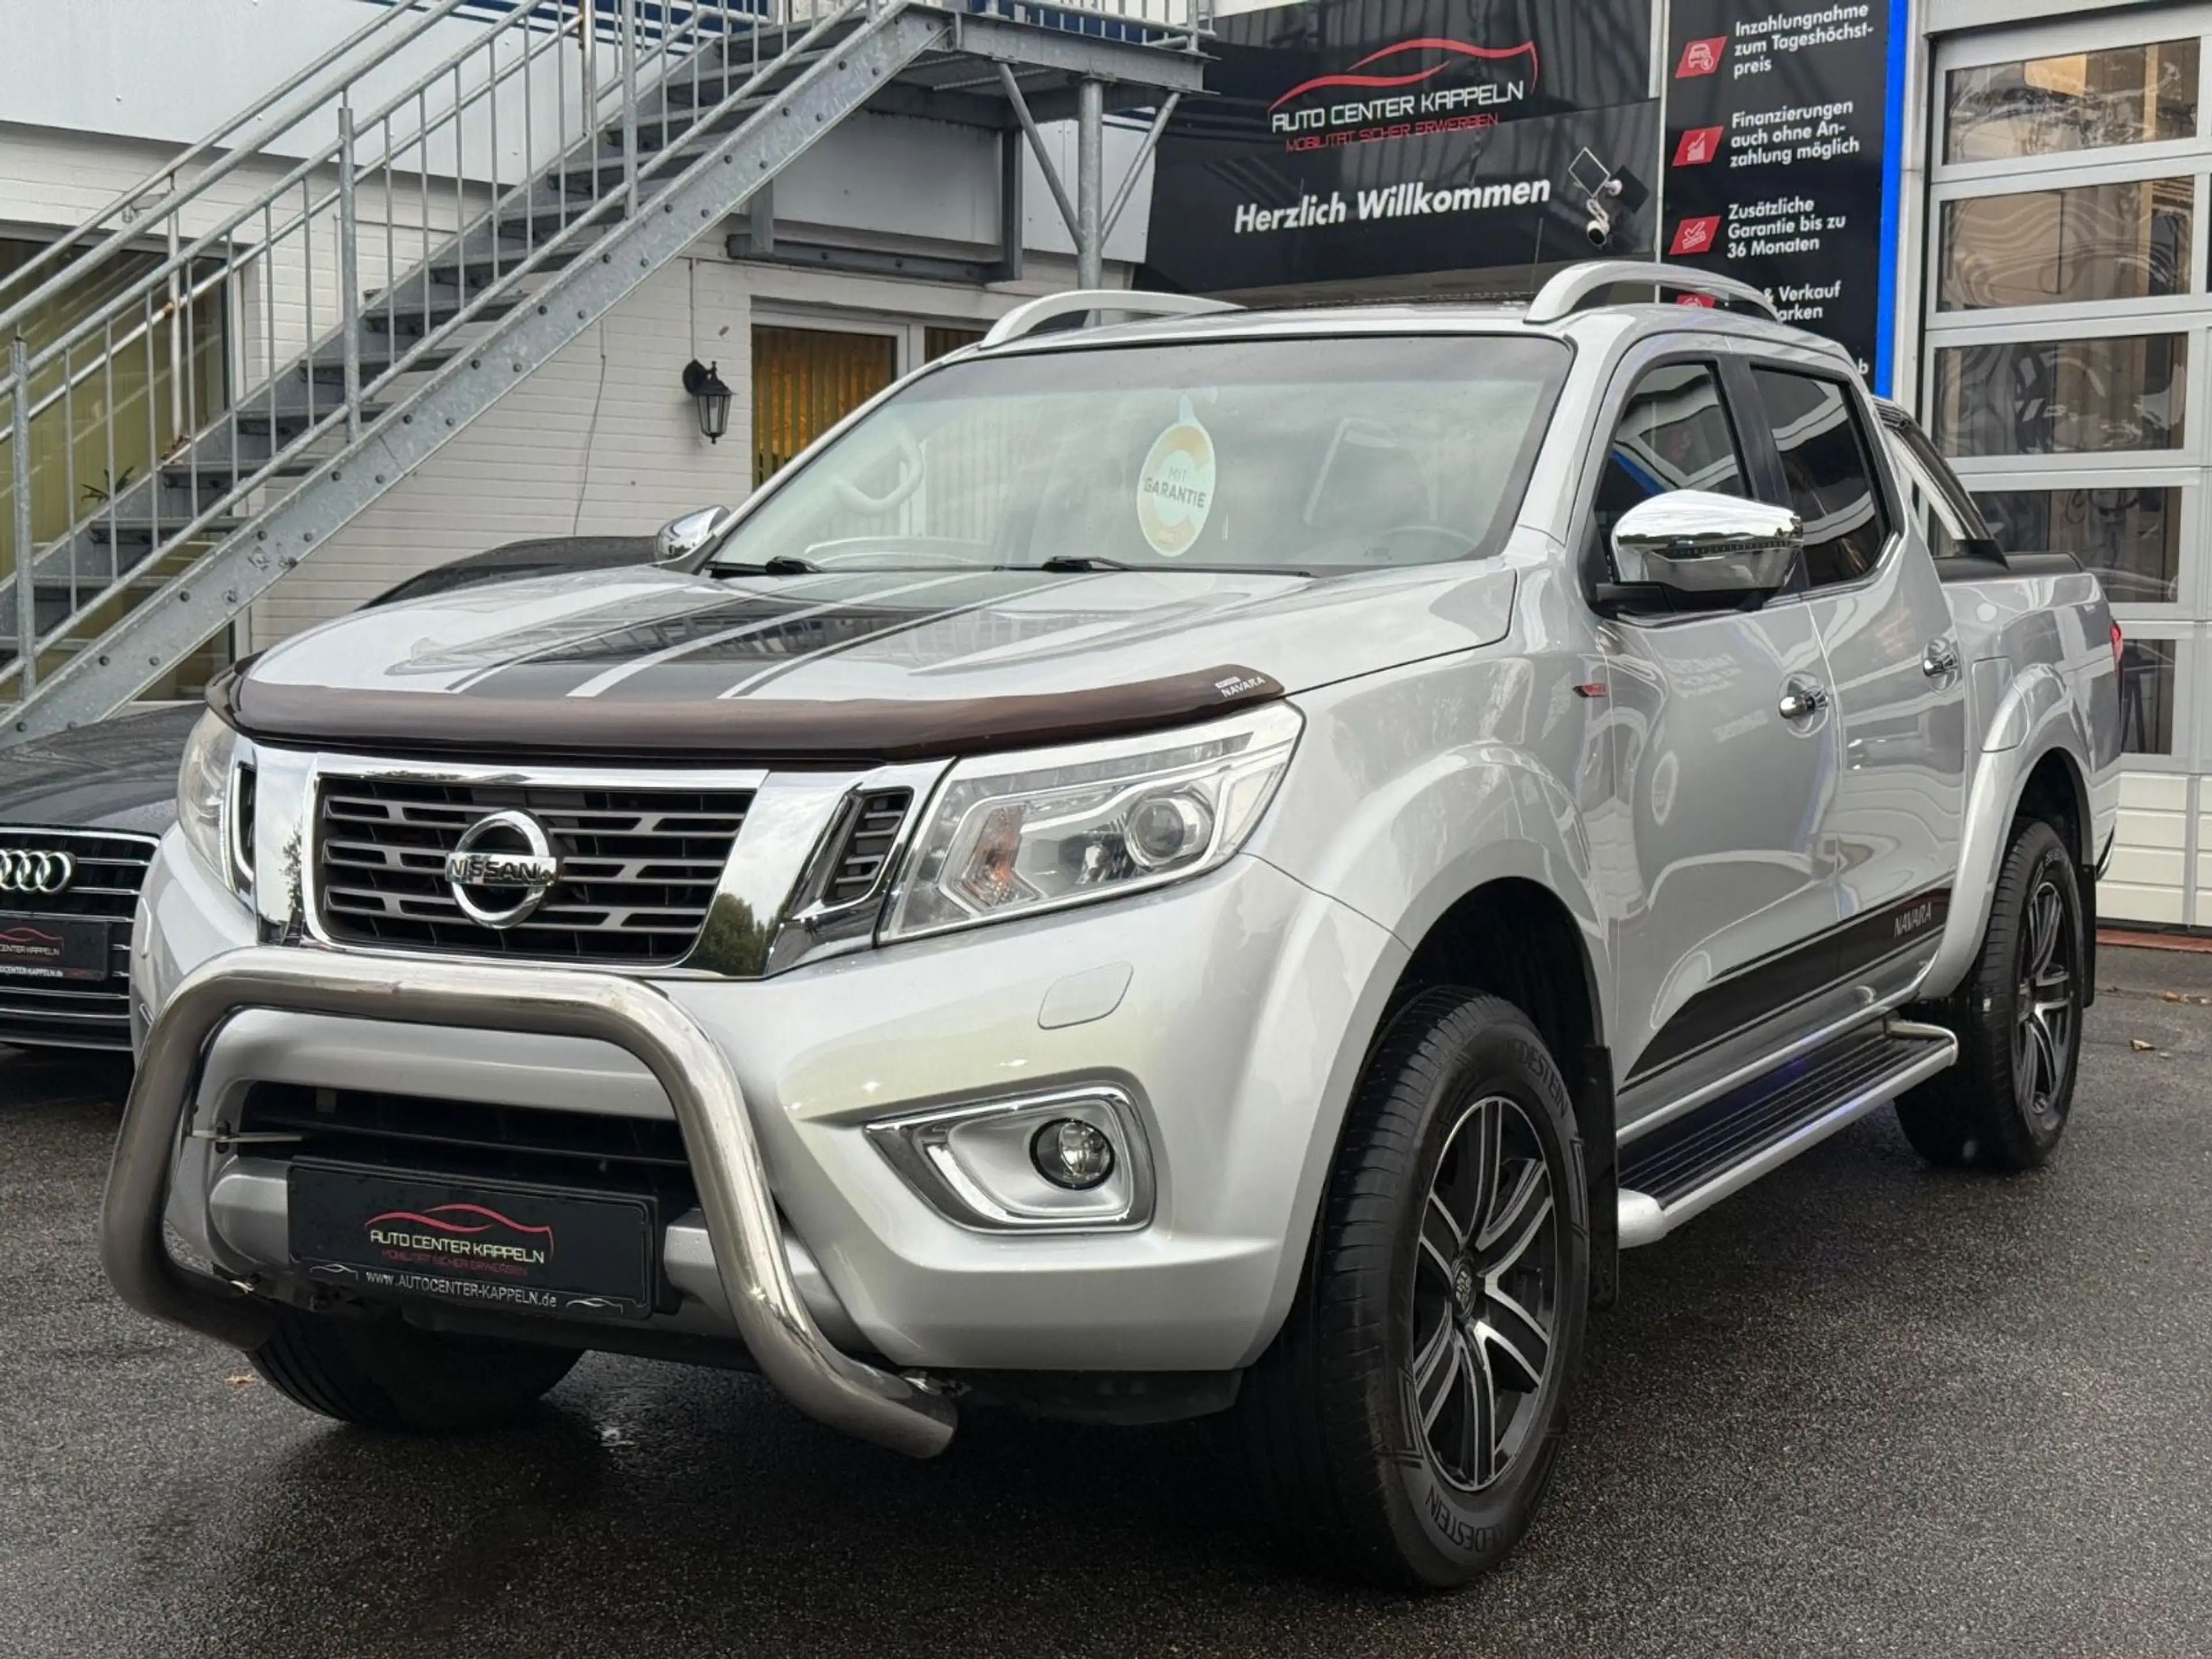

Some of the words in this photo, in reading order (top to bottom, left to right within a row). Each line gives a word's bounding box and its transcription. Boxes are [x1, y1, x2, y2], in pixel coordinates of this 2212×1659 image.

[1736, 5, 1869, 36] Inzahlungnahme
[1734, 40, 1767, 56] zum
[1771, 22, 1874, 51] Tageshöchst-
[1733, 56, 1772, 79] preis
[1272, 109, 1324, 133] AUTO
[1331, 95, 1414, 125] CENTER
[1421, 80, 1524, 113] KAPPELN
[1732, 101, 1853, 128] Finanzierungen
[1731, 128, 1768, 147] auch
[1772, 125, 1812, 143] ohne
[1816, 120, 1846, 137] An-
[1730, 147, 1792, 168] zahlung
[1797, 137, 1860, 160] möglich
[1234, 192, 1346, 233] Herzlich
[1357, 179, 1551, 220] Willkommen
[1728, 196, 1815, 220] Zusätzliche
[1728, 218, 1796, 239] Garantie
[1800, 215, 1823, 232] bis
[1827, 215, 1846, 229] zu
[1727, 242, 1747, 258] 36
[1751, 237, 1820, 256] Monaten
[1778, 279, 1842, 302] Verkauf
[1775, 304, 1823, 321] arken
[1143, 477, 1206, 509] GARANTIE
[1220, 676, 1267, 698] NAVARA
[450, 858, 541, 882] NISSAN
[1893, 902, 1931, 938] NAVARA
[370, 1230, 410, 1247] AUTO
[412, 1235, 471, 1255] CENTER
[473, 1243, 545, 1264] KAPPELN
[366, 1271, 557, 1308] www.AUTOCENTER-KAPPELN.de
